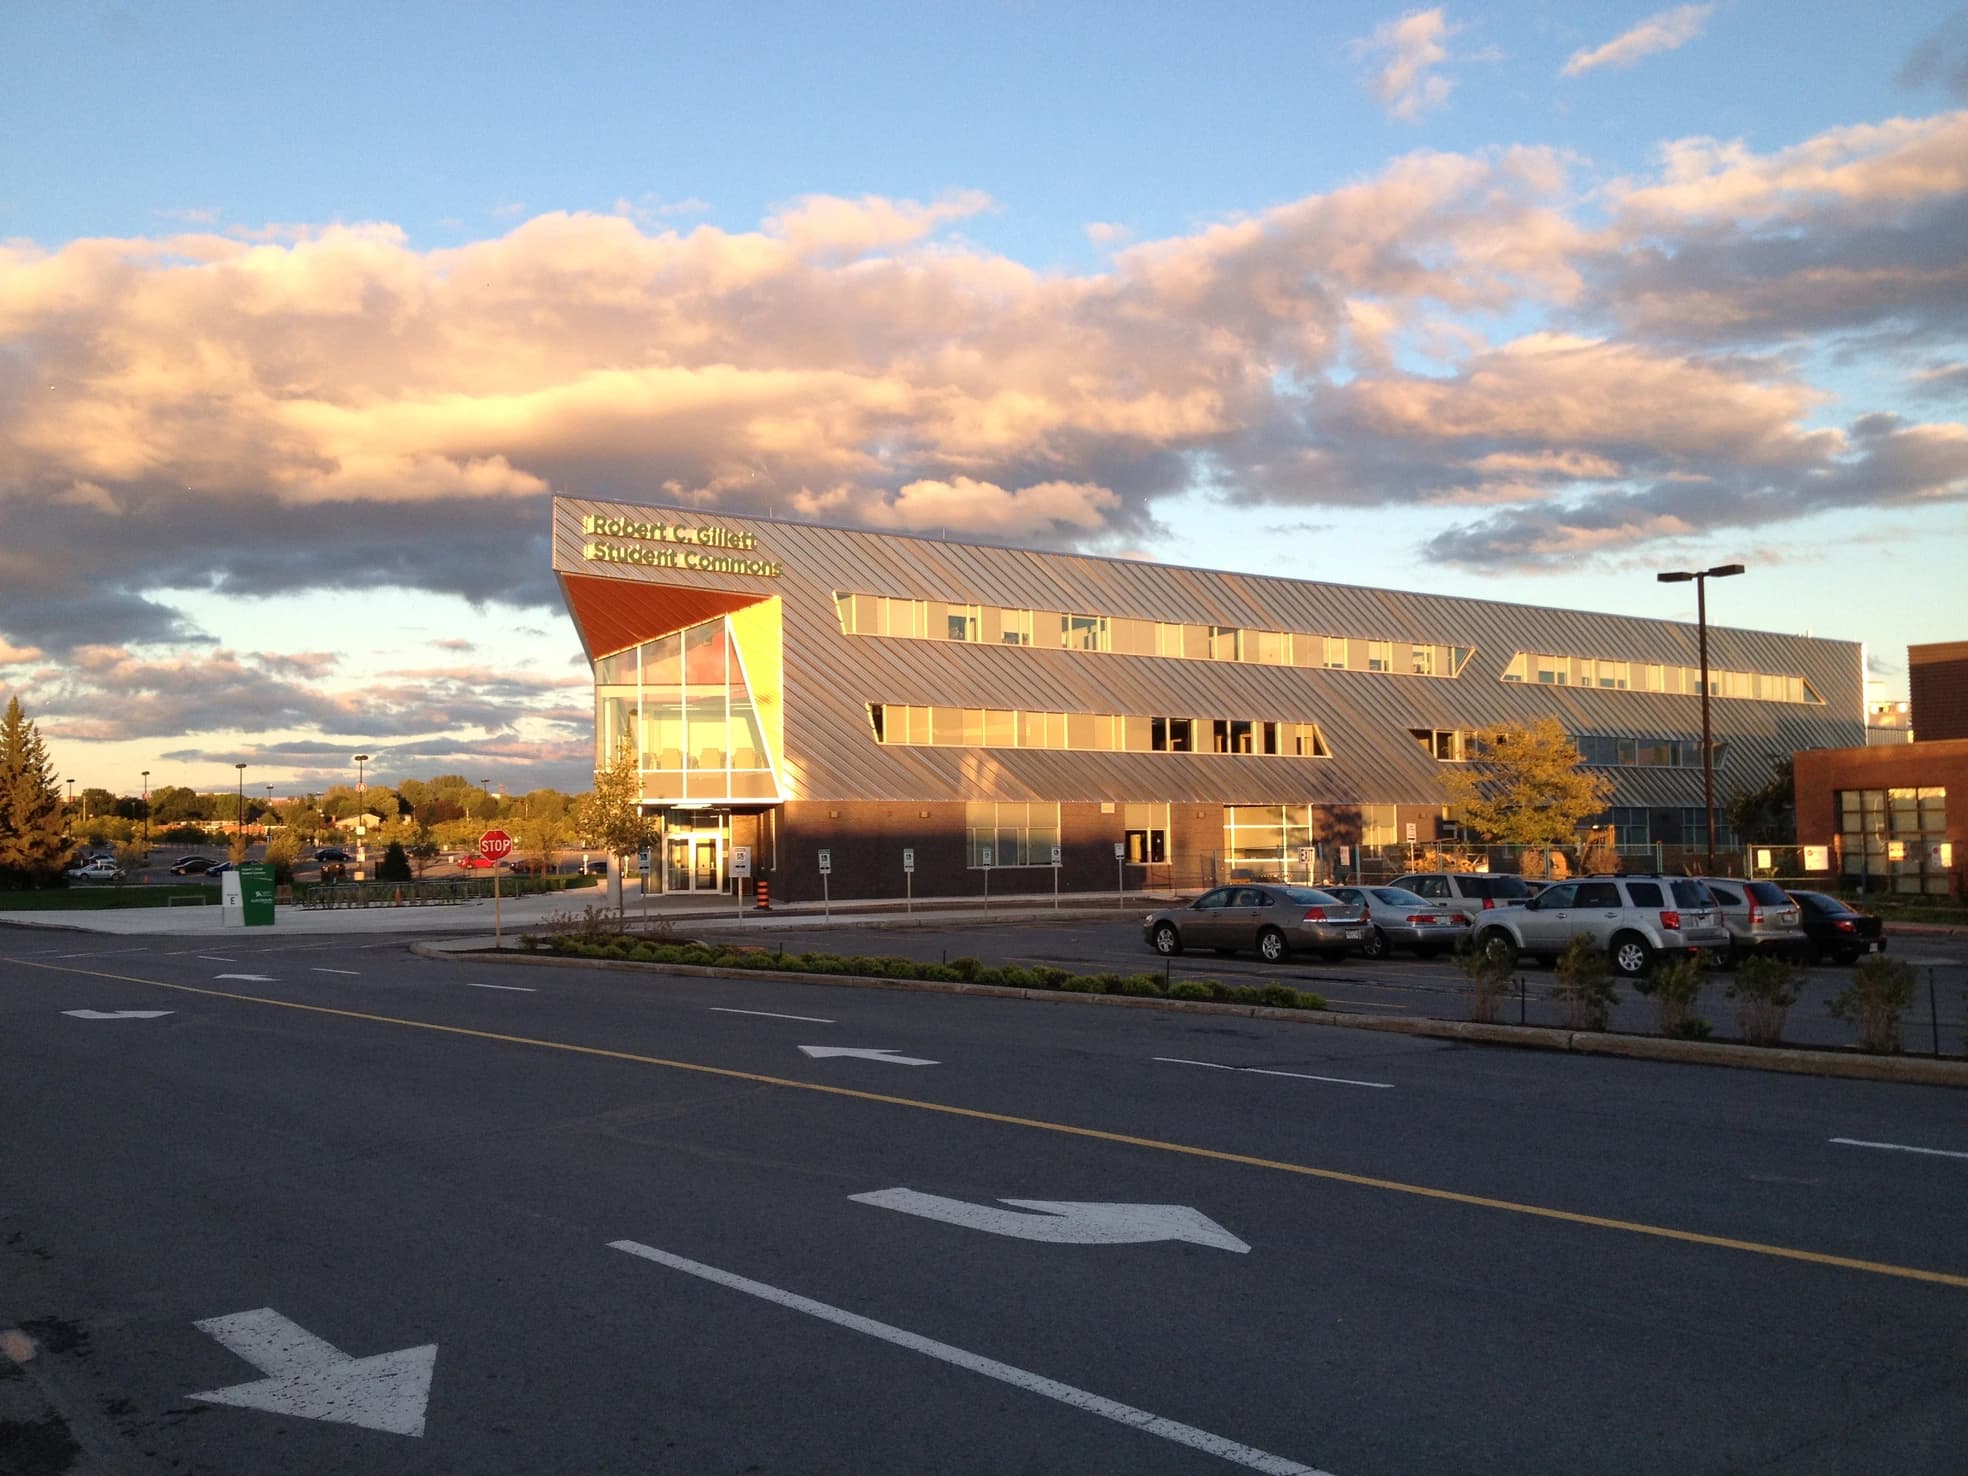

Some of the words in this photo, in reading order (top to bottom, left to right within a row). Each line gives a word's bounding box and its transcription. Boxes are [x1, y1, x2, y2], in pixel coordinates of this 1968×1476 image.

[593, 515, 667, 541] Robert
[672, 523, 693, 542] C.
[696, 527, 758, 549] Gillett
[593, 541, 677, 565] Student
[684, 550, 783, 576] Commons
[481, 839, 511, 853] STOP
